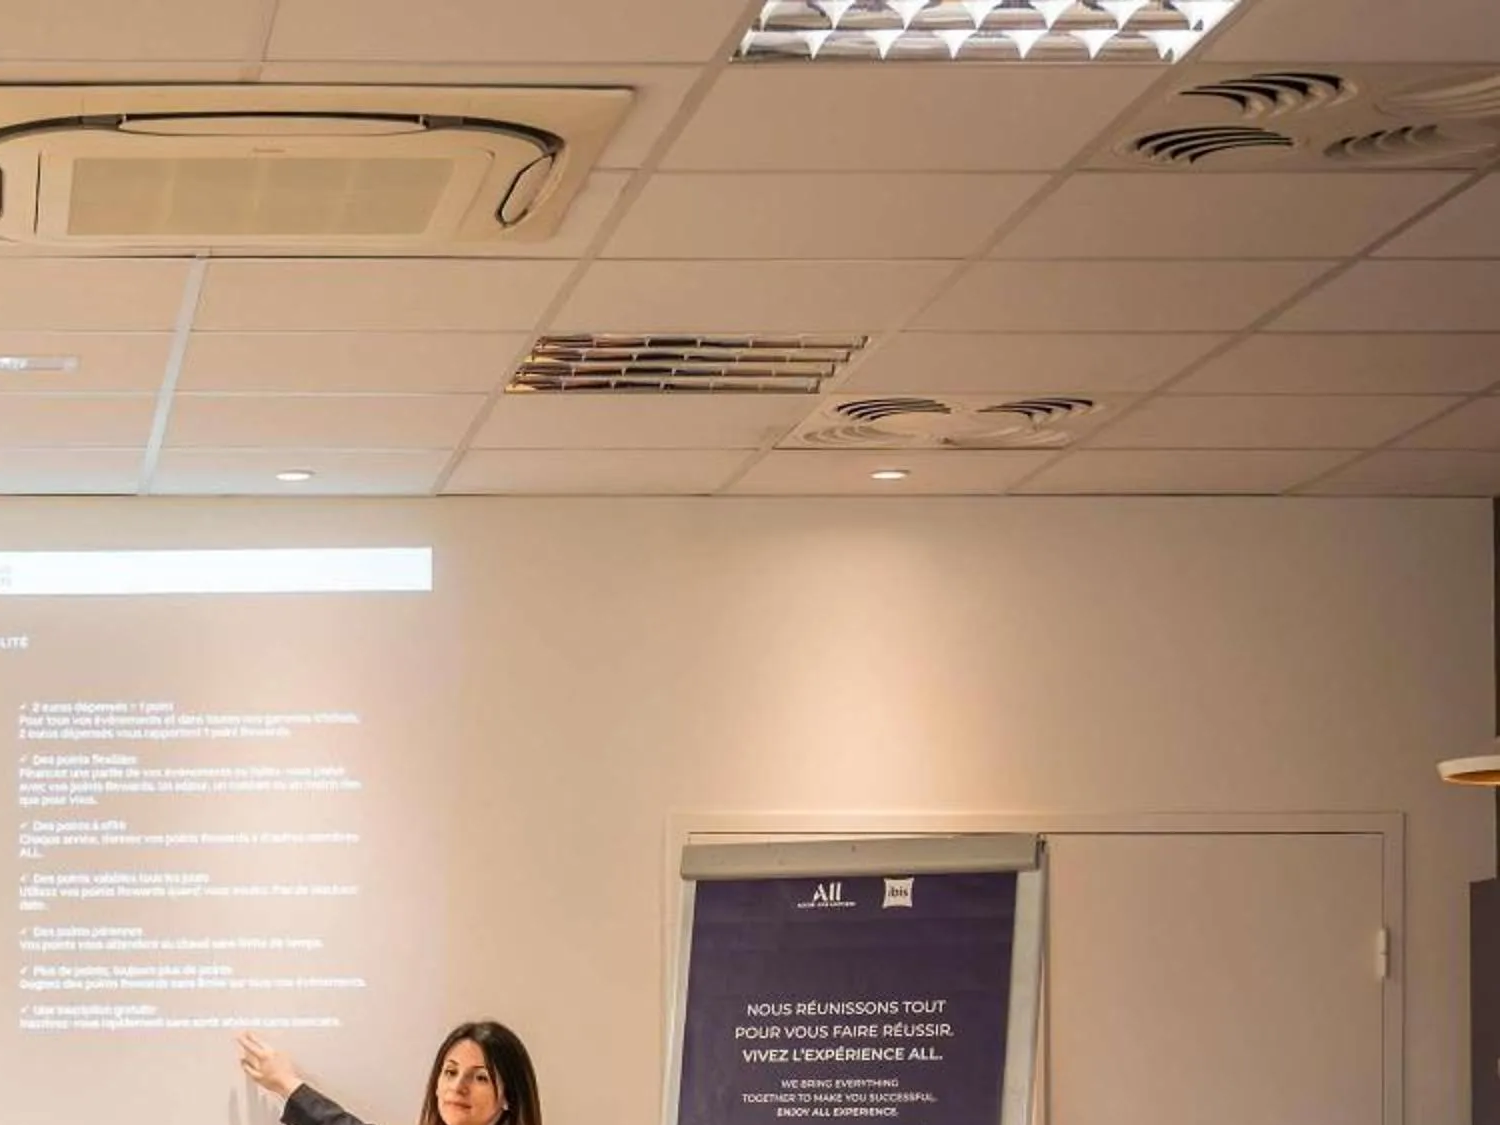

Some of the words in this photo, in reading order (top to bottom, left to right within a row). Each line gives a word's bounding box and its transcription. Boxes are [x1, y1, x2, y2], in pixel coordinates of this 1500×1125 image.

[813, 882, 842, 902] All
[888, 885, 908, 897] ibis
[747, 1003, 793, 1016] NOUS
[796, 1001, 899, 1015] RÉUNISSONS
[902, 1000, 947, 1014] TOUT
[735, 1026, 781, 1039] POUR
[784, 1025, 829, 1039] VOUS
[833, 1024, 878, 1037] FAIRE
[883, 1022, 954, 1037] RÉUSSIR.
[742, 1050, 789, 1063] VIVEZ
[792, 1046, 905, 1062] L'EXPÉRIENCE
[907, 1048, 943, 1061] ALL.
[781, 1079, 798, 1089] WE
[800, 1079, 833, 1089] BRING
[835, 1078, 899, 1088] EVERYTHING
[741, 1093, 796, 1103] TOGETHER
[797, 1093, 812, 1103] TO
[813, 1093, 843, 1103] MAKE
[845, 1093, 866, 1102] YOU
[777, 1107, 809, 1117] ENJOY
[811, 1107, 831, 1117] ALL
